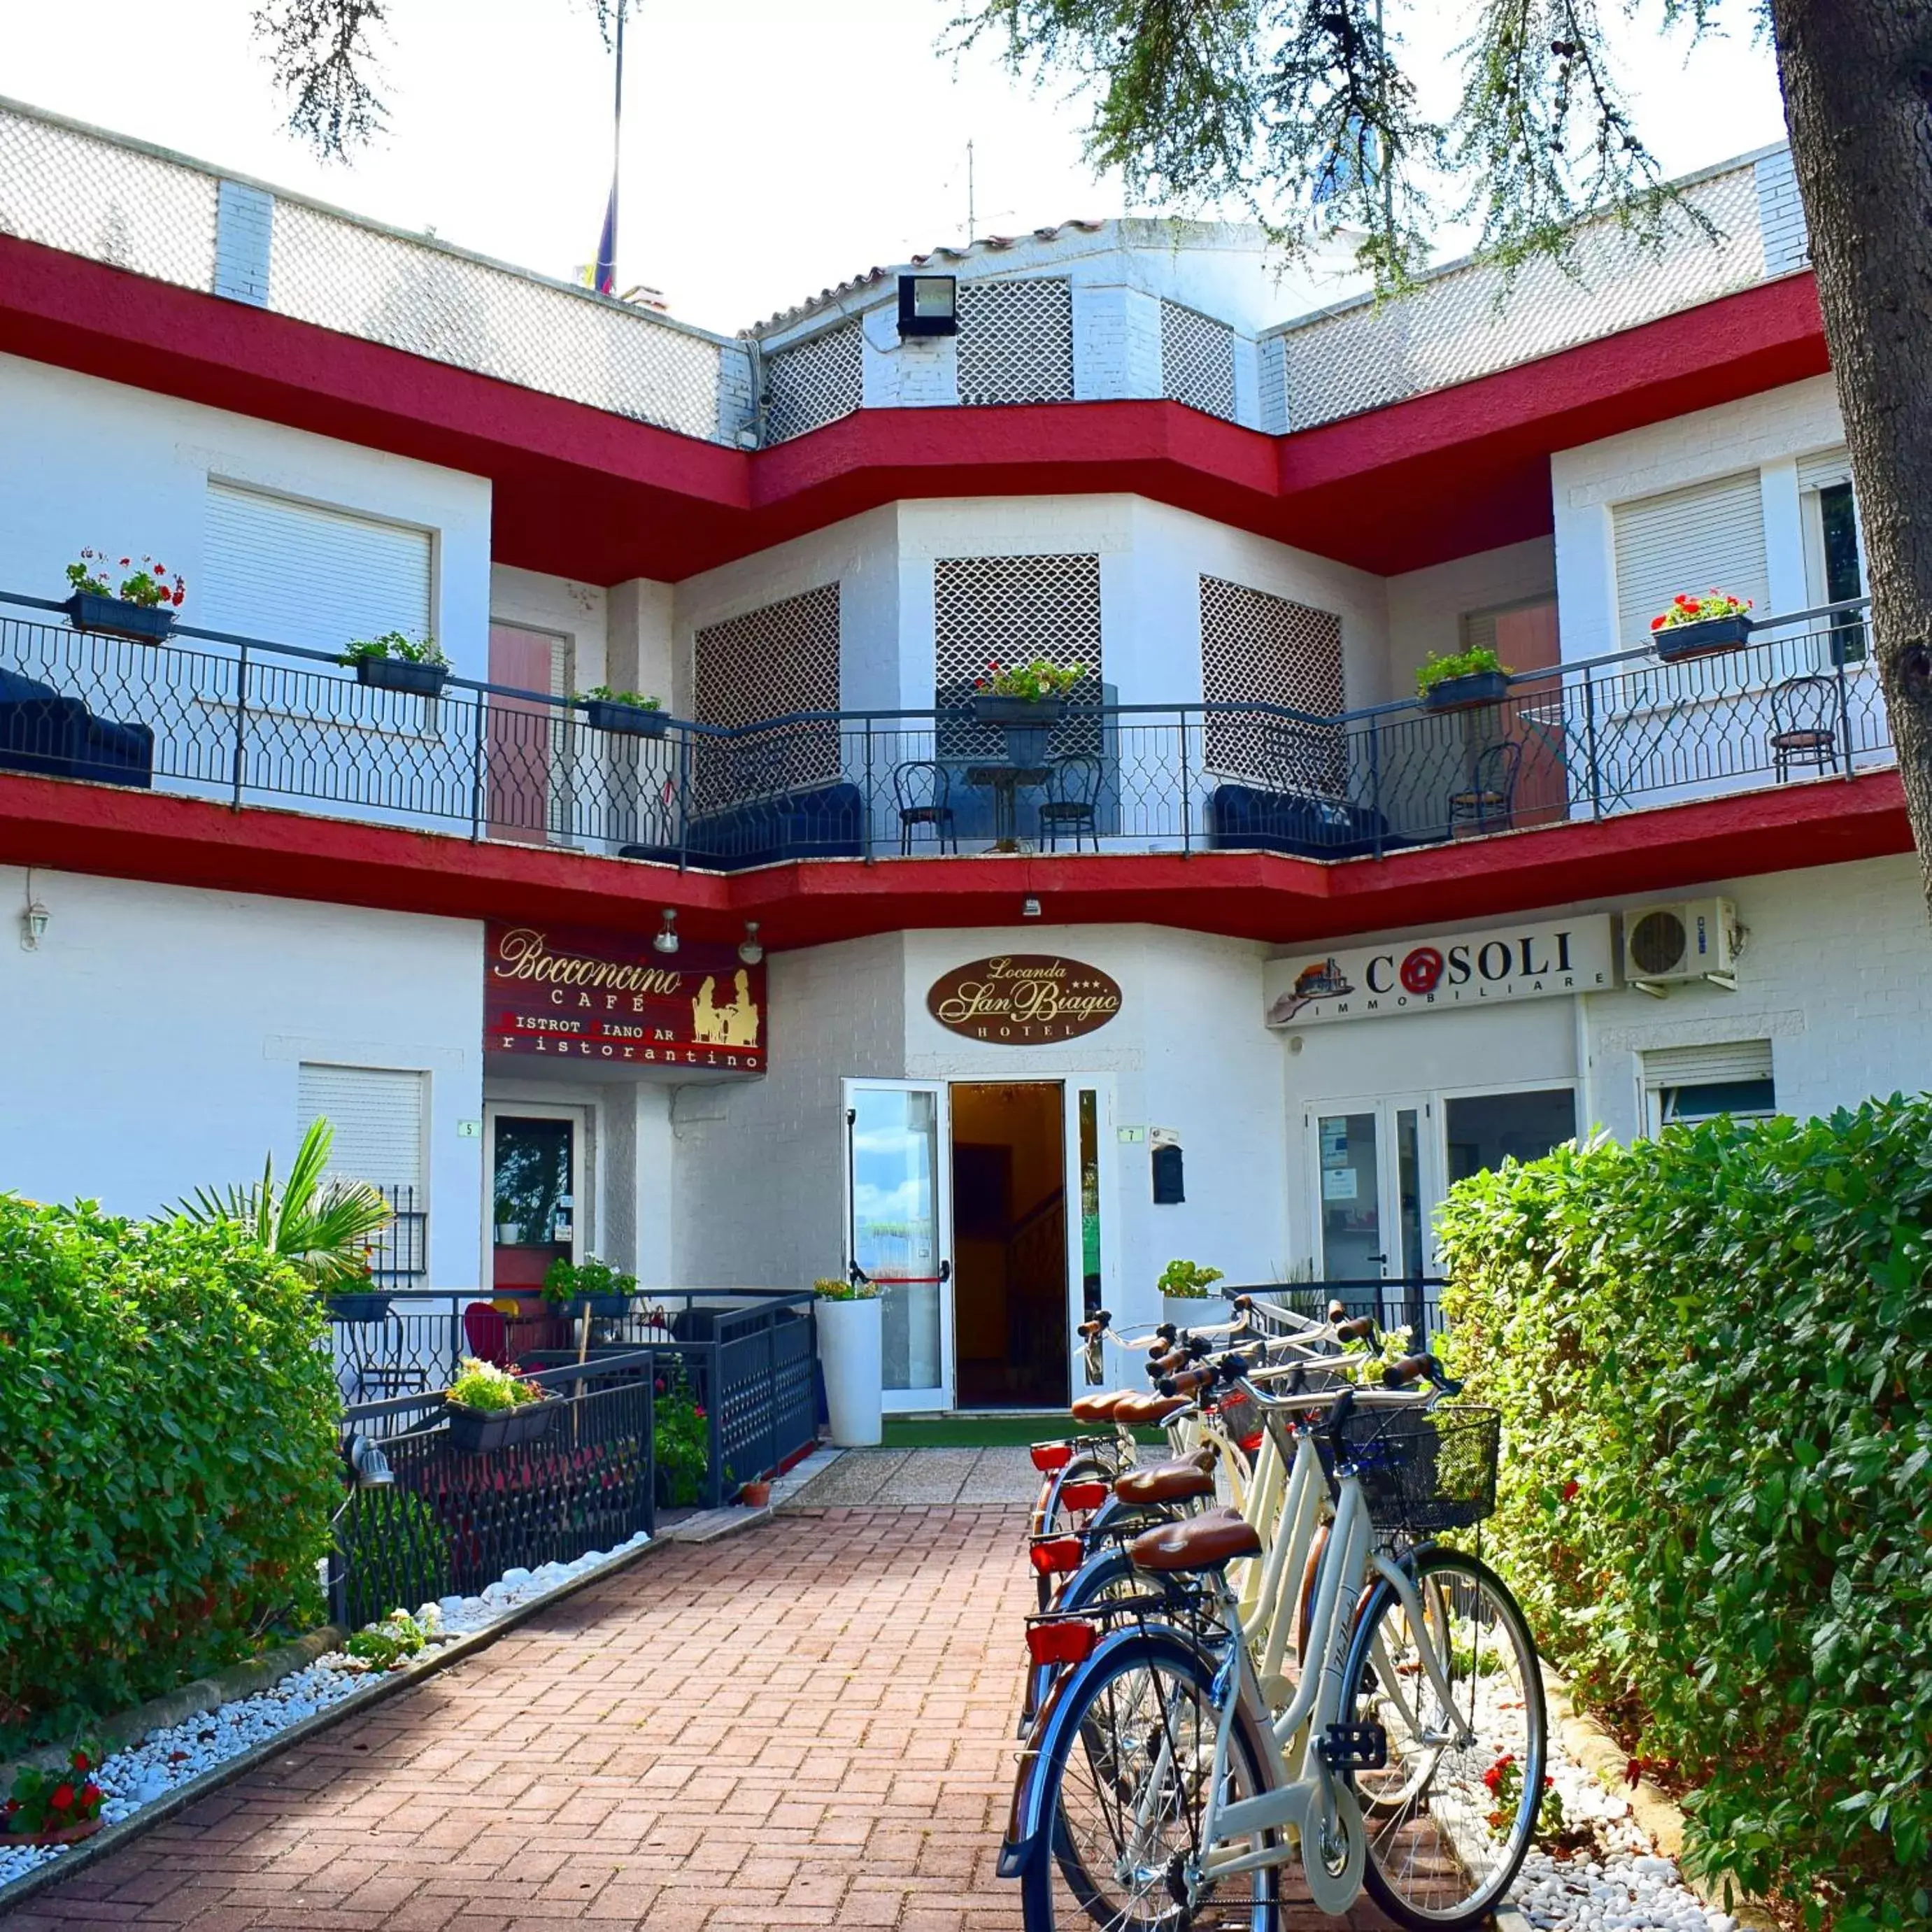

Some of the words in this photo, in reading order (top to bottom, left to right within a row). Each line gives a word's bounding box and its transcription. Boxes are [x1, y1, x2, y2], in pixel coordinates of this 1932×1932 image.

[495, 928, 681, 993] Bocconcino
[987, 958, 1067, 979] Locanda
[551, 989, 644, 1012] CAFÉ
[939, 981, 1014, 1023] San
[1010, 980, 1119, 1022] Biagio
[1316, 973, 1604, 1016] IMMOBILIARE
[502, 1011, 581, 1033] ISTROT
[590, 1019, 643, 1038] IANO
[978, 1025, 1074, 1037] HOTEL
[502, 1035, 758, 1068] ristorantino
[467, 1123, 472, 1135] 5
[1128, 1130, 1134, 1142] 7
